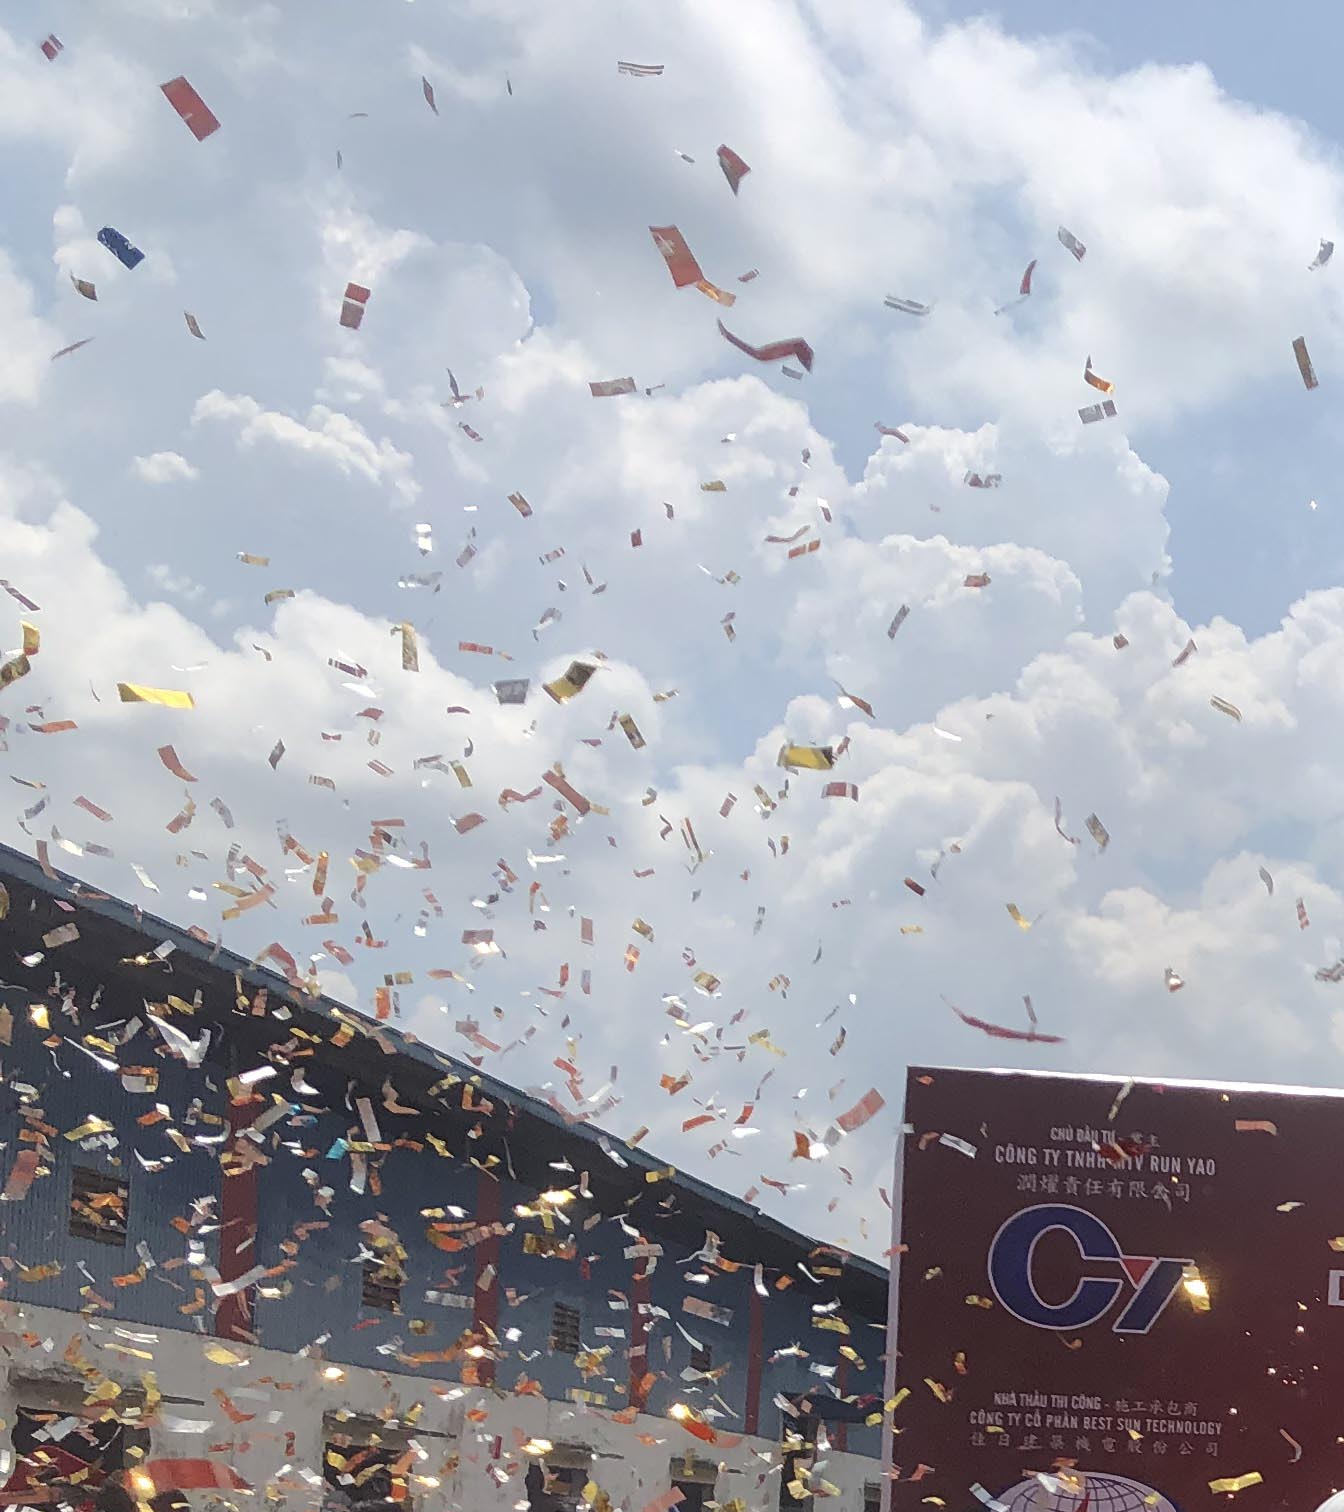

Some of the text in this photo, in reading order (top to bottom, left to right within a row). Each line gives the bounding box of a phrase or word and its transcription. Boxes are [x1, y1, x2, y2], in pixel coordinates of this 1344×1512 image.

[995, 1143, 1038, 1165] CÔNG
[1043, 1149, 1060, 1167] TY
[1150, 1155, 1181, 1174] RUN
[1187, 1158, 1216, 1176] YAO
[1050, 1394, 1068, 1409] THI
[969, 1409, 1003, 1426] CÔNG
[1007, 1412, 1022, 1427] TY
[1083, 1416, 1113, 1431] BEST
[1116, 1417, 1141, 1433] SUN
[1145, 1418, 1223, 1436] TECHNOLOGY
